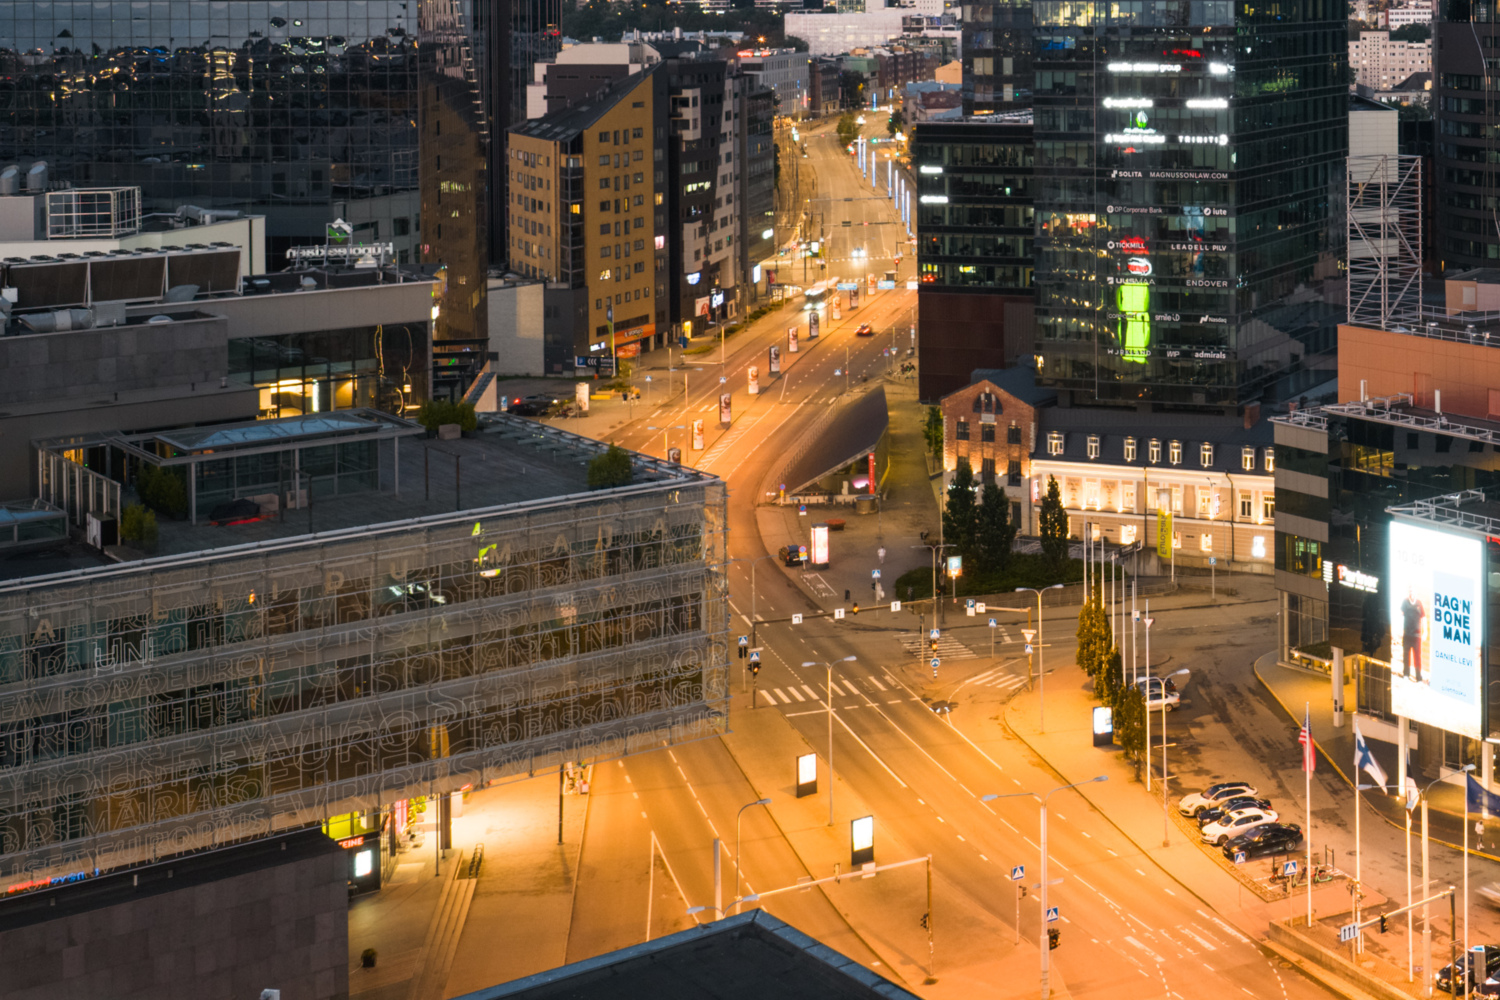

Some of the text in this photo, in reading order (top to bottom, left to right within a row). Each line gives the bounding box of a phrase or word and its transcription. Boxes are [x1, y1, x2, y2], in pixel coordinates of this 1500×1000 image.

[1149, 171, 1228, 179] MAGNUSSONLAW.COM
[1123, 206, 1147, 214] Corporate
[1212, 208, 1227, 216] iute
[1115, 241, 1146, 249] TICKMILL
[1171, 243, 1210, 251] LEADELL
[1115, 277, 1155, 285] UUSMAA
[1186, 279, 1228, 288] ENDOVER
[1194, 350, 1226, 359] admirals
[1434, 608, 1471, 630] BONE
[1443, 625, 1471, 646] MAN
[1435, 650, 1473, 668] DANIEL LEVI
